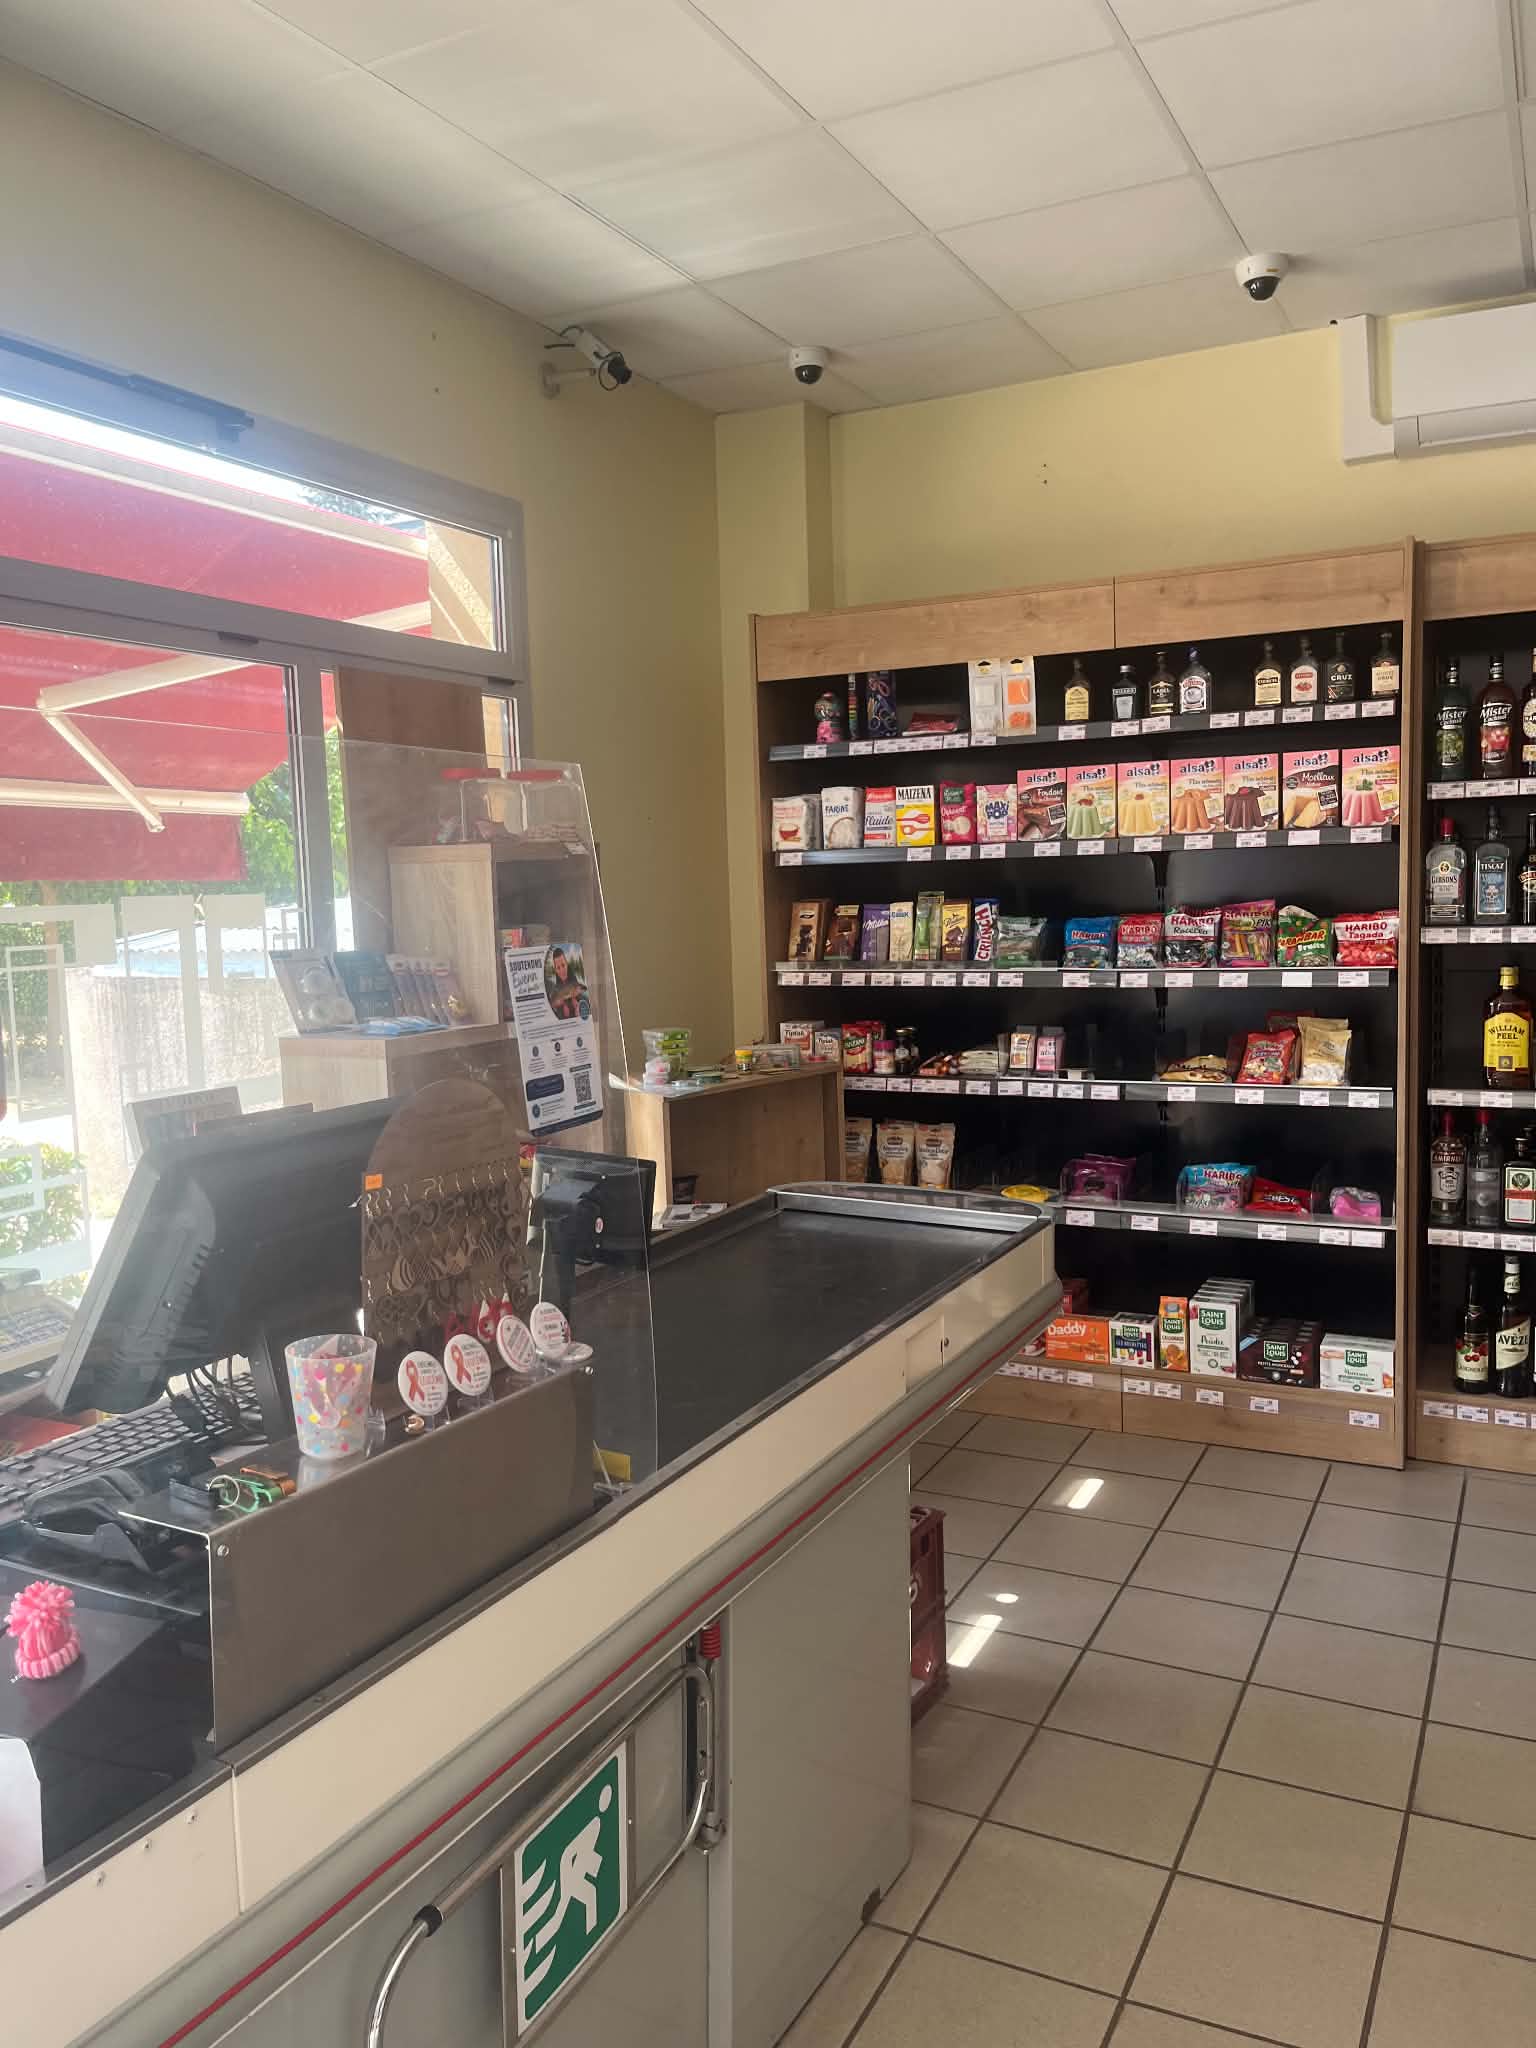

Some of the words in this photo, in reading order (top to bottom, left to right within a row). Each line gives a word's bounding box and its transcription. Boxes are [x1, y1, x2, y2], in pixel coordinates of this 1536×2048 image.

[1437, 710, 1467, 721] Mister
[1480, 706, 1512, 720] Mister
[1293, 756, 1319, 766] alsa
[1352, 752, 1379, 763] alsa
[1180, 763, 1205, 773] alsa
[1234, 760, 1259, 770] alsa
[1076, 770, 1098, 780] alsa
[1126, 767, 1151, 777] alsa
[1026, 772, 1048, 783] alsa
[897, 787, 932, 800] MAIZENA
[1120, 924, 1160, 935] HARIBO
[1345, 921, 1388, 932] HARIBO
[1348, 931, 1384, 941] Tagada
[1488, 1024, 1525, 1035] WILLIAM
[1496, 1032, 1519, 1040] PEEL
[1200, 1310, 1225, 1318] SAINT
[1201, 1317, 1225, 1326] LOUIS
[1047, 1319, 1087, 1337] Daddy
[1265, 1341, 1287, 1351] SAINT
[1265, 1349, 1287, 1358] LOUIS
[1346, 1350, 1367, 1359] SAINT
[1347, 1356, 1367, 1365] LOUIS
